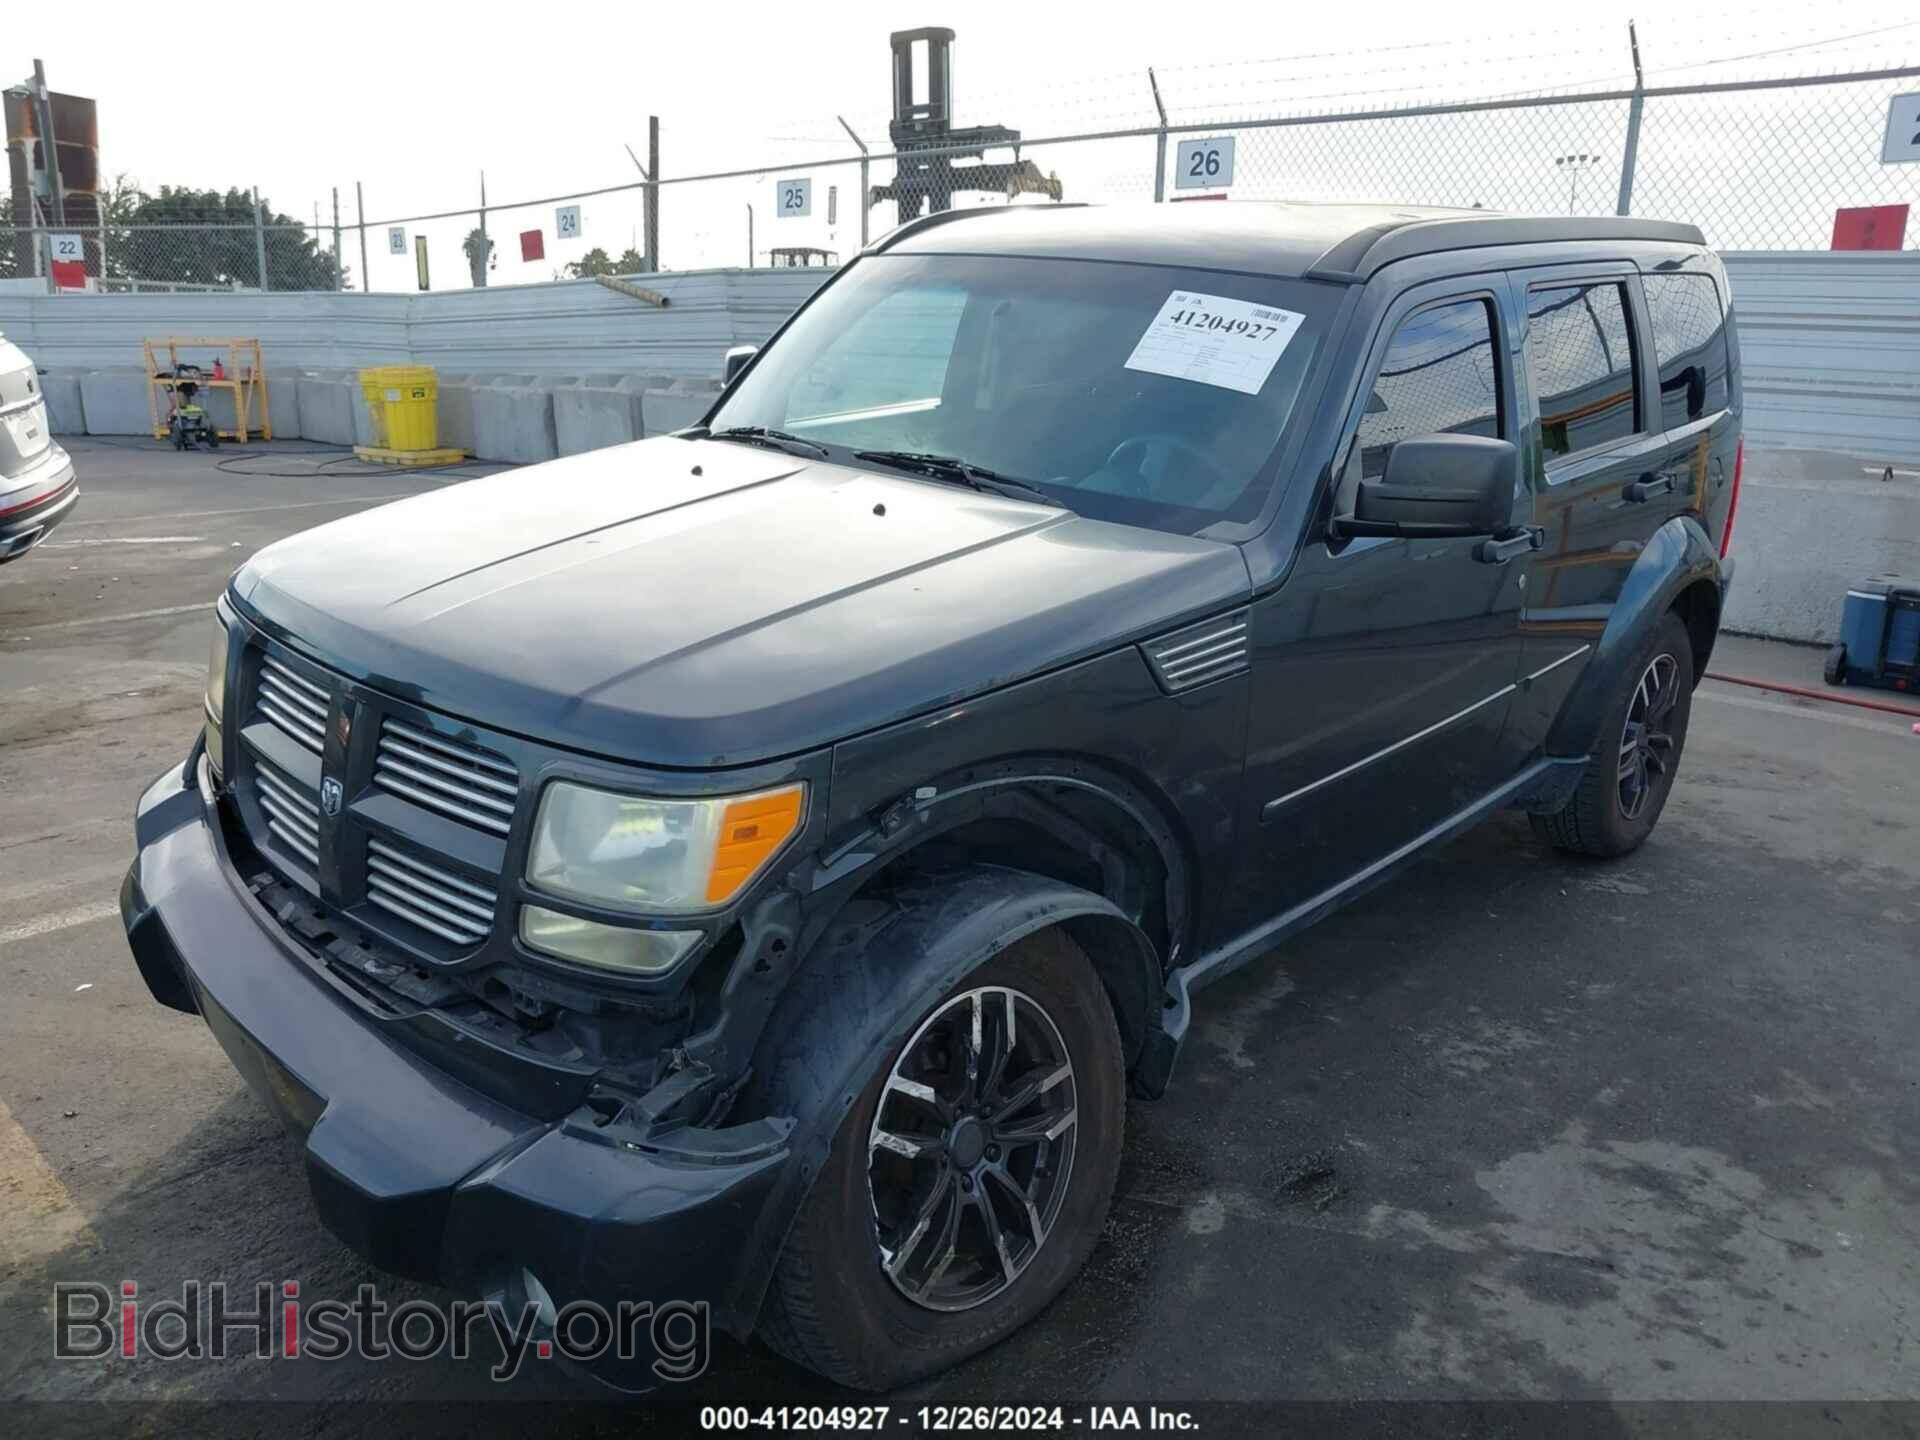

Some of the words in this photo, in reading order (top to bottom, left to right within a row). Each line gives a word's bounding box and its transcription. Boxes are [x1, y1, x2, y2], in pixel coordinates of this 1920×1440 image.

[1190, 150, 1220, 176] 26
[785, 188, 804, 208] 25
[562, 214, 576, 231] 24
[59, 241, 76, 254] 22
[1170, 309, 1278, 341] 41204927
